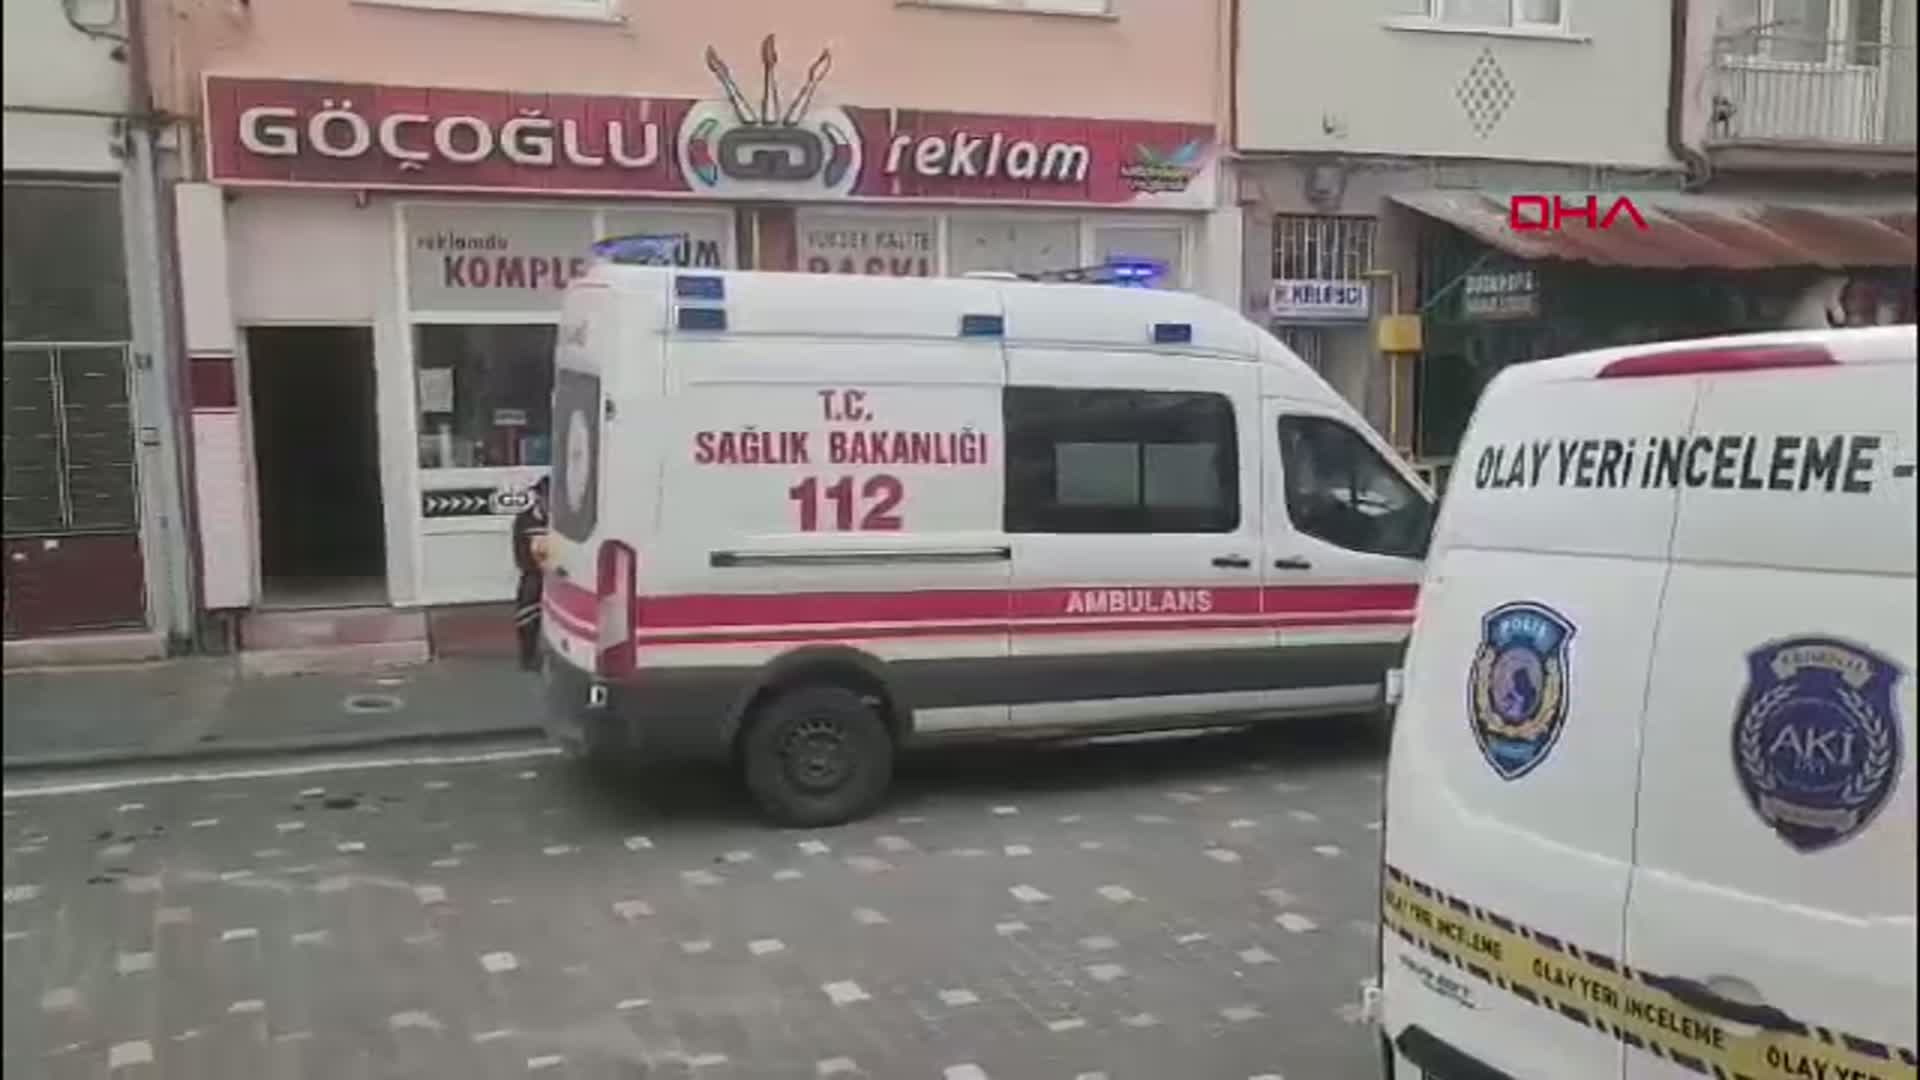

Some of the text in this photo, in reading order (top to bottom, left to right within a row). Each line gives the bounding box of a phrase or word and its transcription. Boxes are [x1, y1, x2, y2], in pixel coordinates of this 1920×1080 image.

[238, 98, 659, 171] GÖÇOĞLU
[885, 131, 1090, 181] reklam
[818, 390, 874, 422] T.C.
[694, 426, 988, 467] SAĞLIK BAKANLIĞI
[1475, 439, 1551, 489] OLAY
[788, 474, 905, 532] 112
[1065, 588, 1213, 615] AMBULANS
[1532, 957, 1576, 990] OLAY
